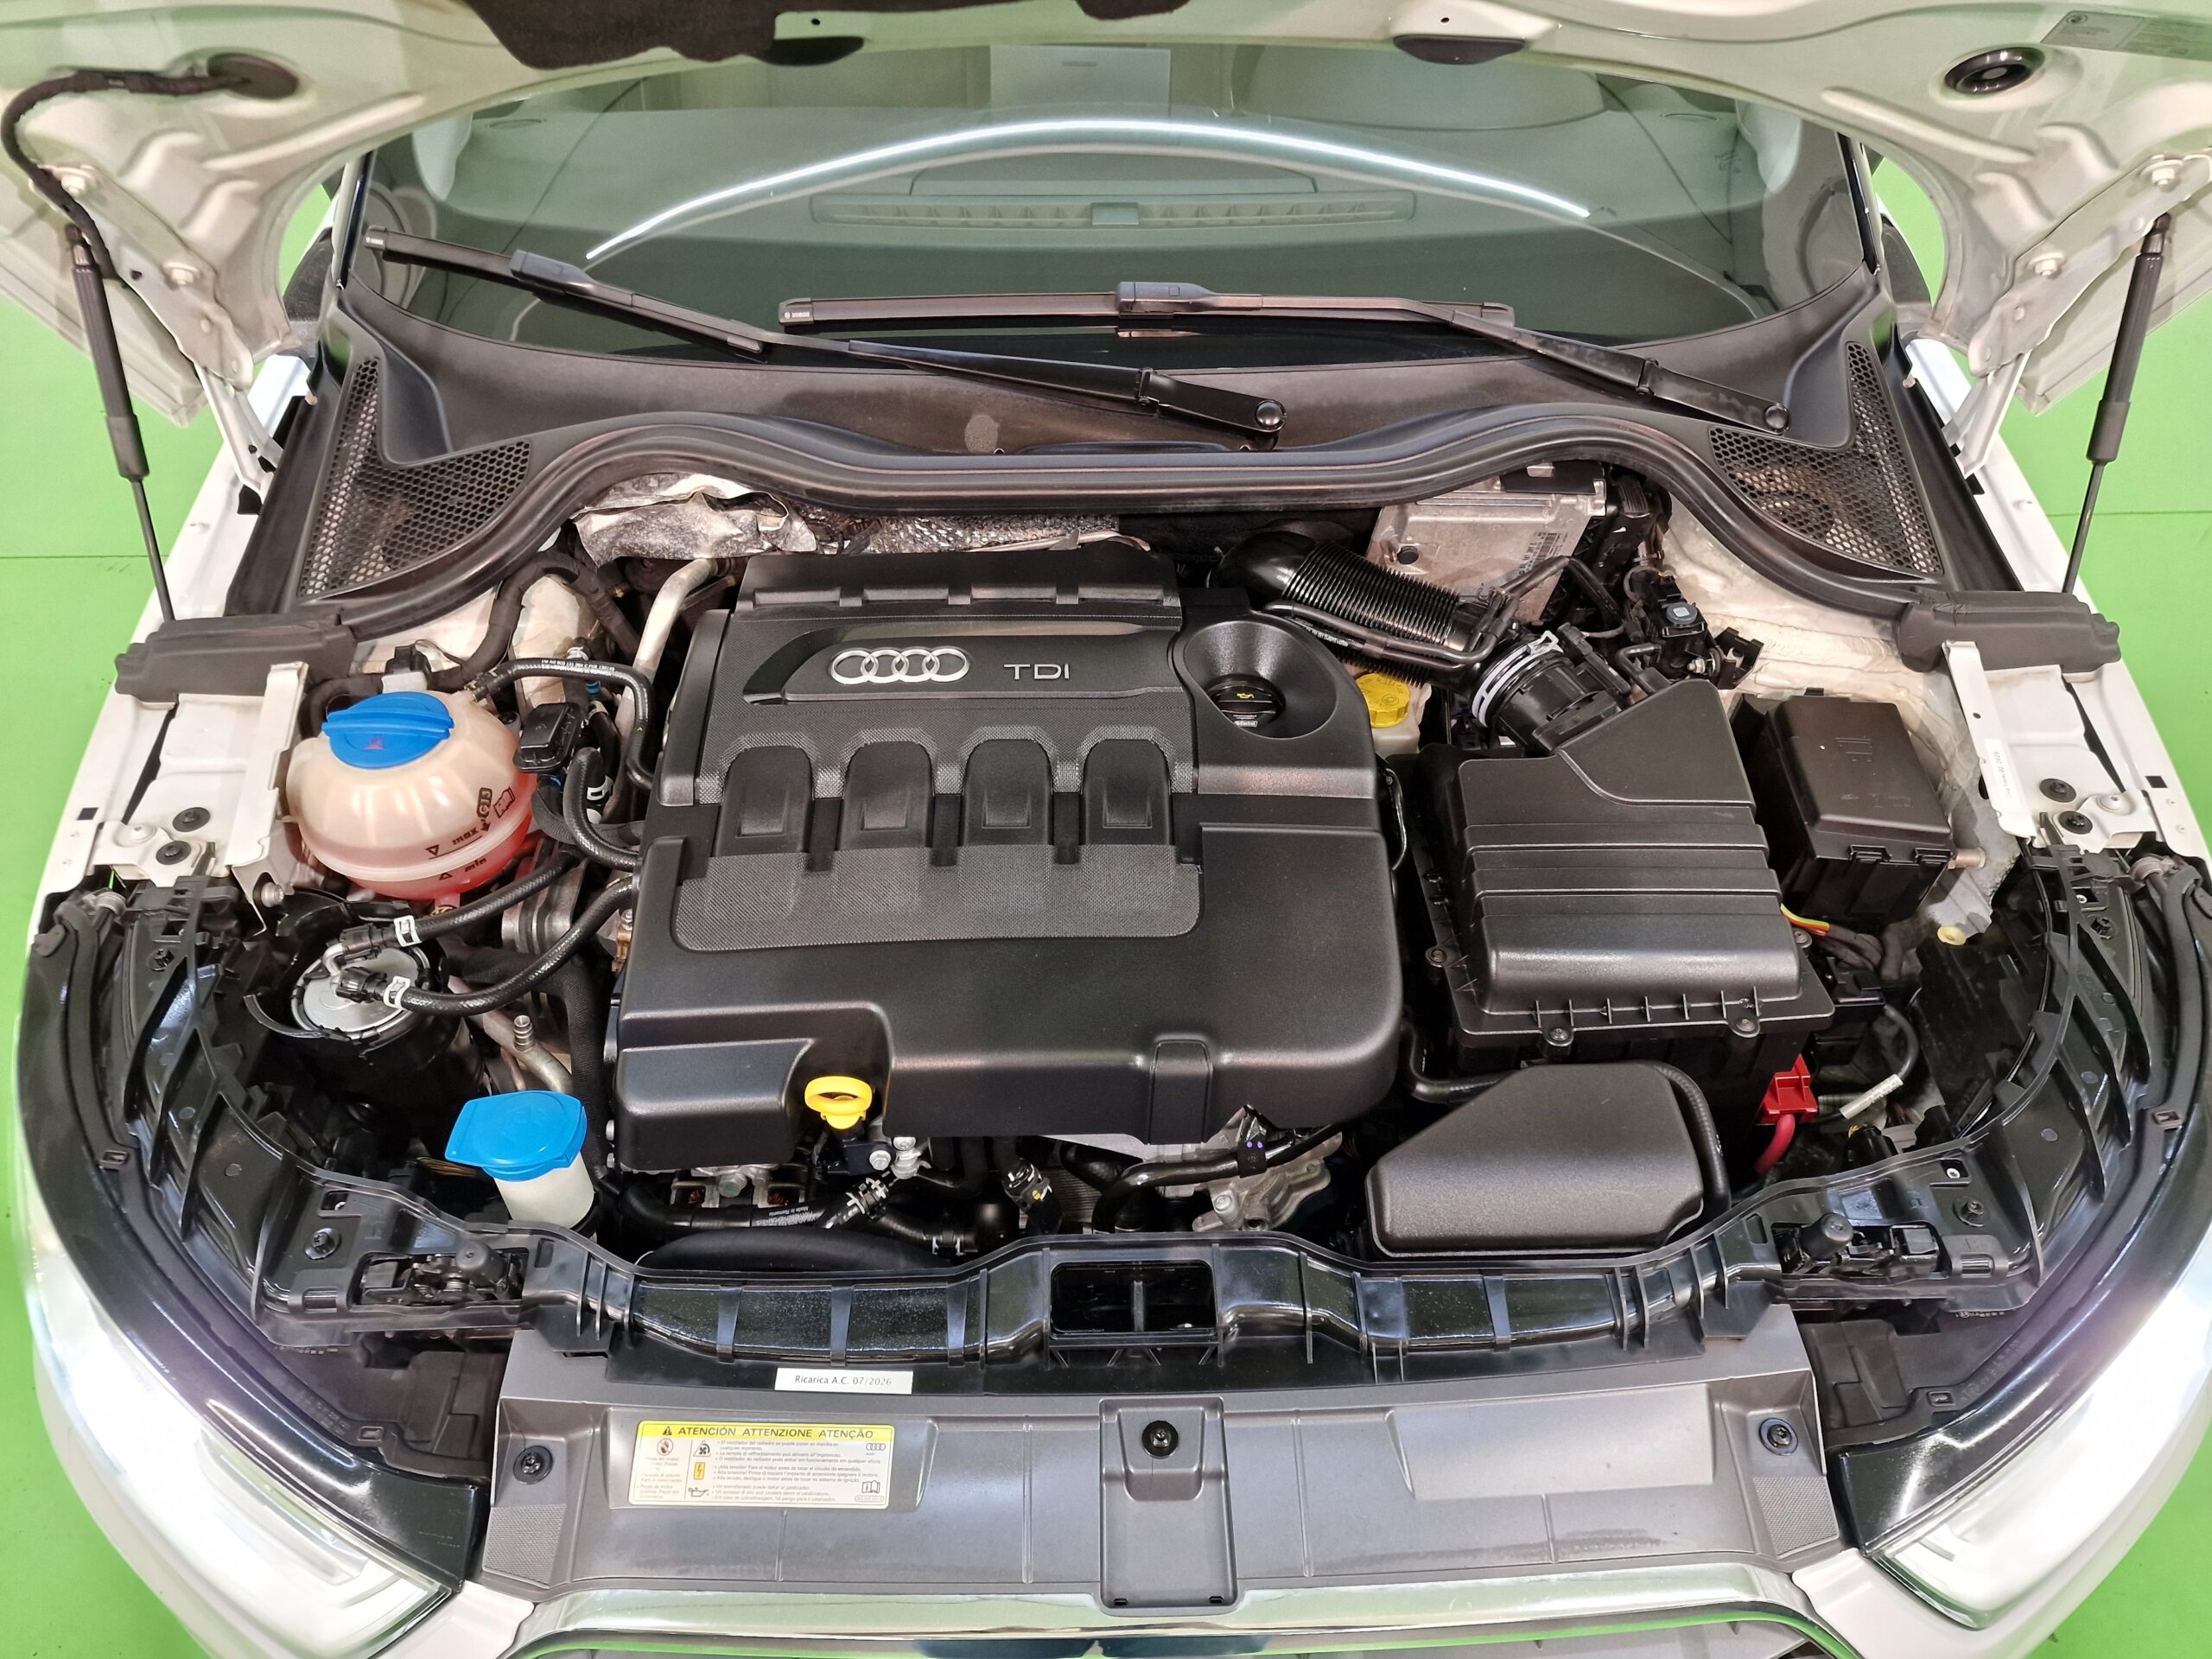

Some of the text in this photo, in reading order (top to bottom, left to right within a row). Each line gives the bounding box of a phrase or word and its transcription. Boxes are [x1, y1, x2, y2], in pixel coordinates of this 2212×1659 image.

[1004, 664, 1069, 680] TDI
[478, 790, 490, 814] G13
[452, 827, 479, 845] max
[464, 858, 486, 872] min
[795, 1375, 891, 1386] Ricarica A.C. 07/2026
[678, 1426, 874, 1440] ATENCIÓN ATTENZIONE ATENÇÃO
